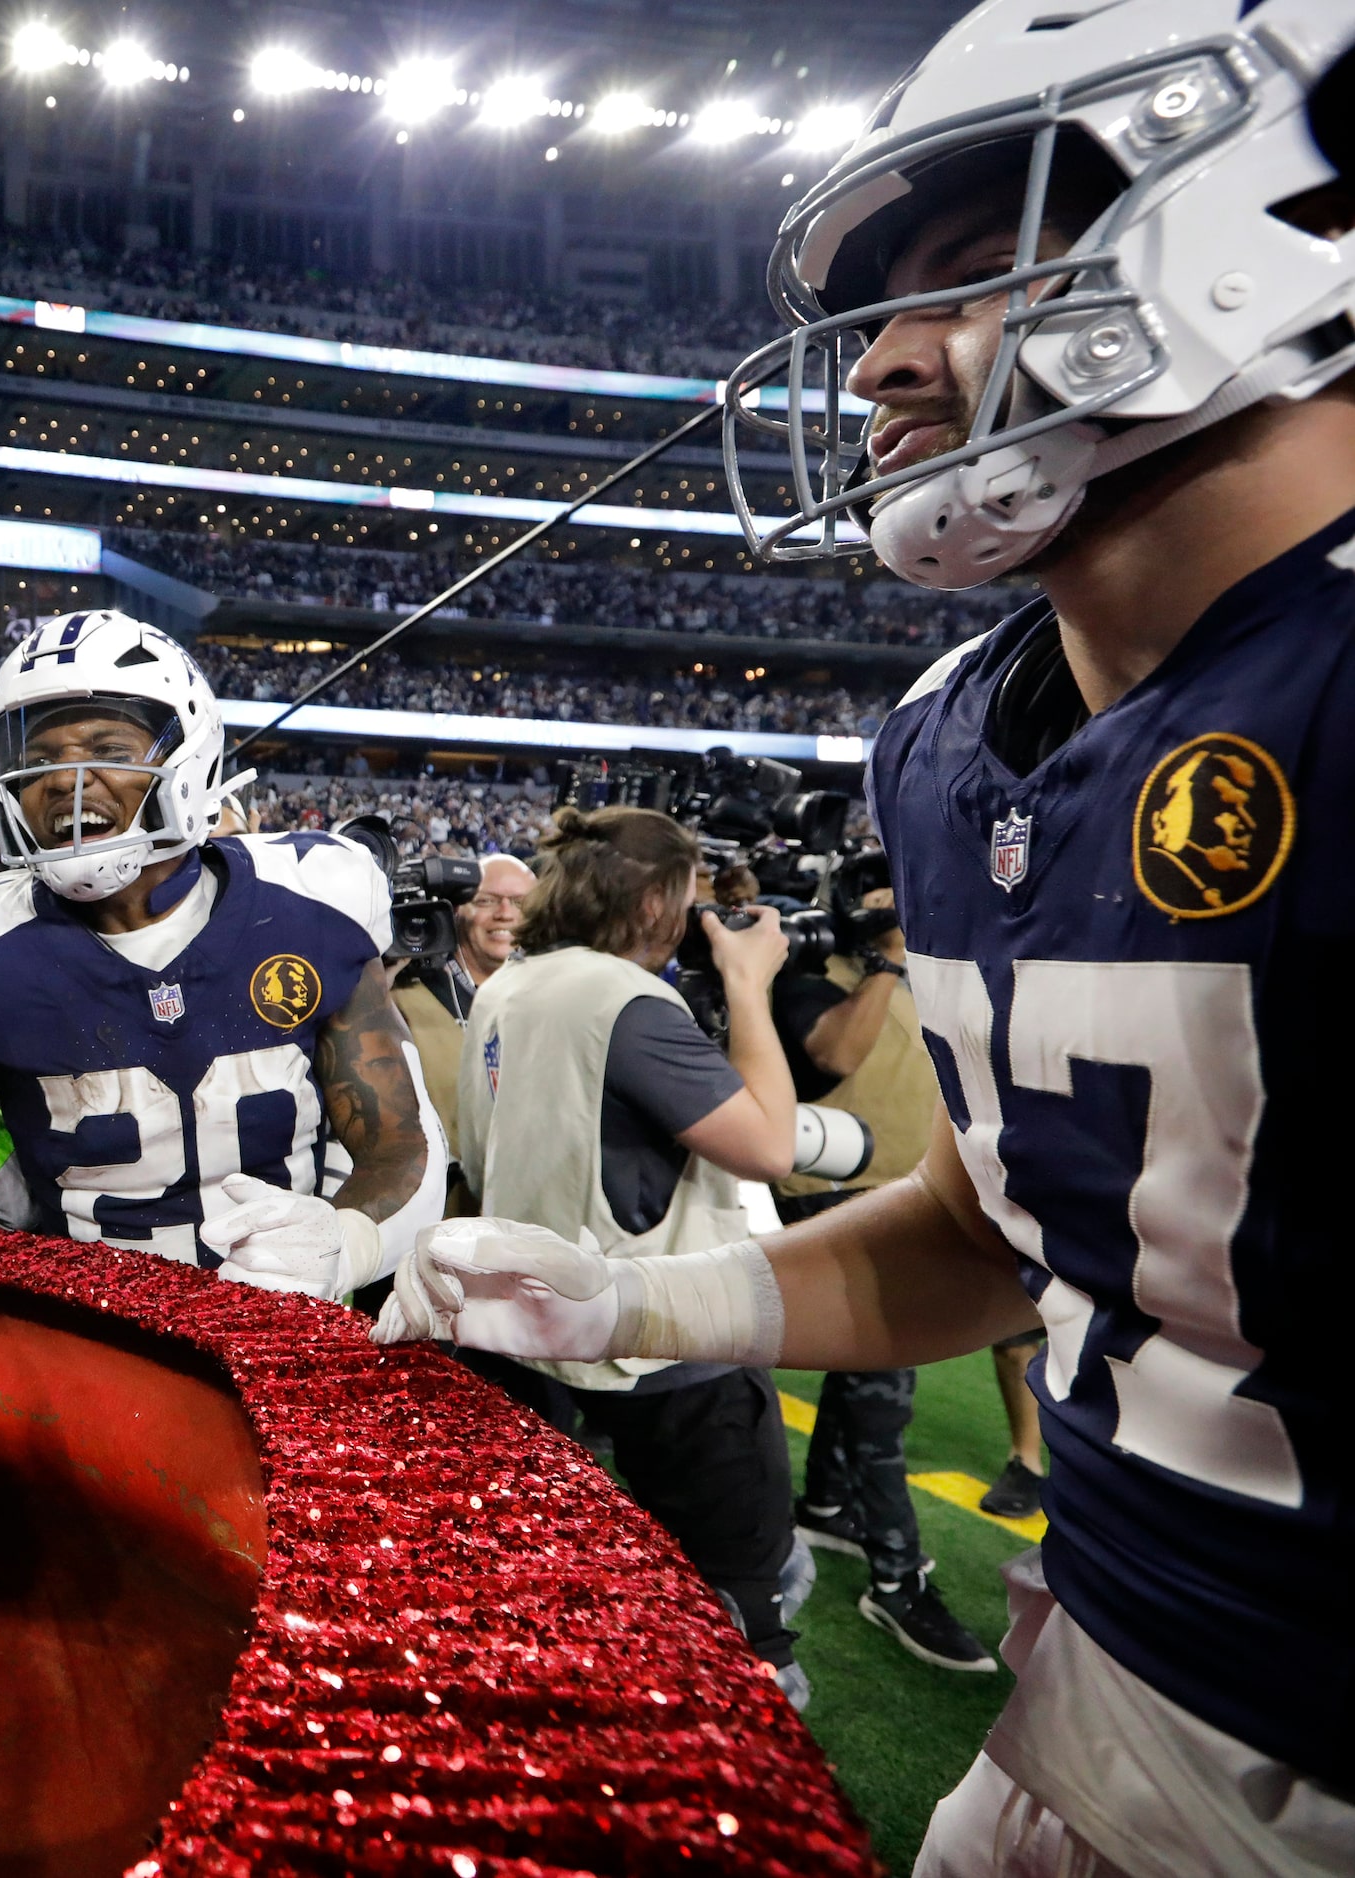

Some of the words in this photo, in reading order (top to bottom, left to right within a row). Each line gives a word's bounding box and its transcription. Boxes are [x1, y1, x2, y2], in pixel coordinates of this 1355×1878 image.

[997, 847, 1023, 878] NFL
[156, 1000, 180, 1017] NFL
[37, 1042, 322, 1268] 20
